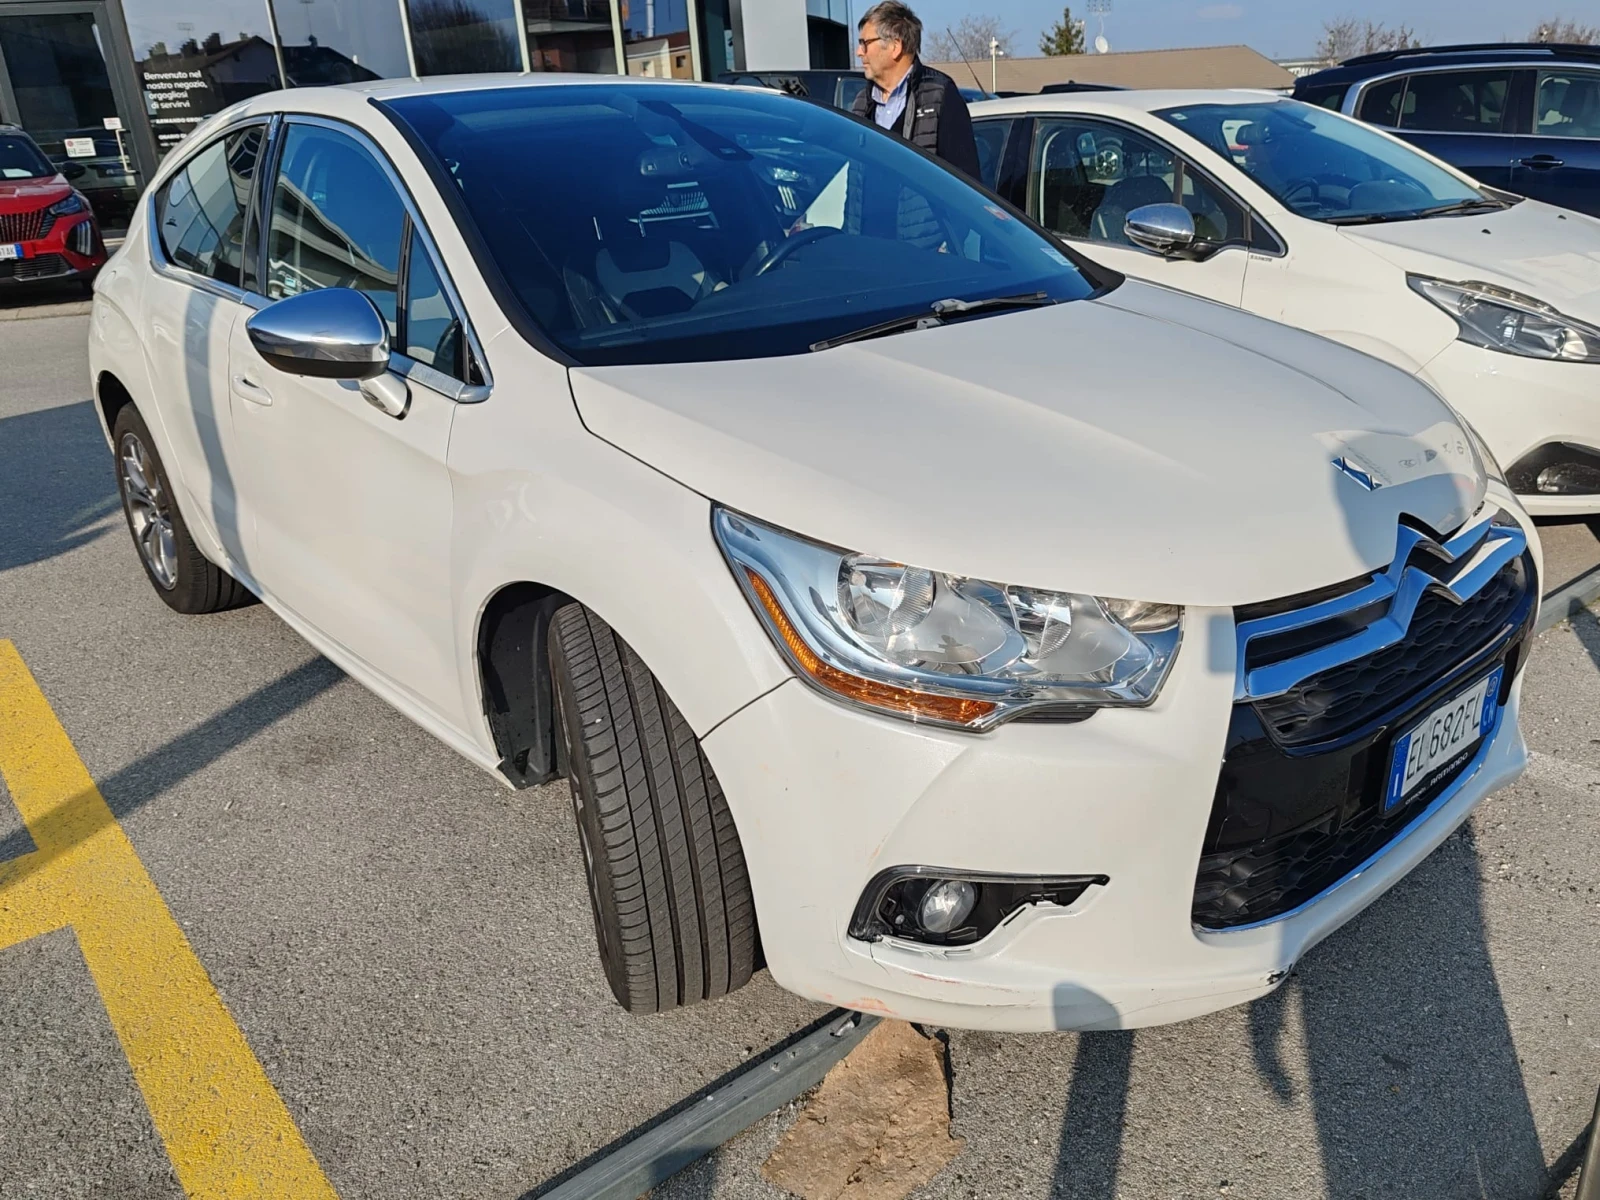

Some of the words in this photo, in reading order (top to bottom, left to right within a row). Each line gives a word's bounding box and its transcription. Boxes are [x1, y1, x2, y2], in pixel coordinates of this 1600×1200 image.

[144, 72, 188, 80] Benvenuto
[189, 70, 202, 78] nel
[146, 82, 173, 90] nostro
[174, 80, 208, 90] negozio,
[149, 91, 188, 100] orgogliosi
[151, 101, 159, 109] di
[160, 100, 191, 109] servirvi
[1406, 733, 1425, 780] EL
[1428, 692, 1481, 759] 682FL
